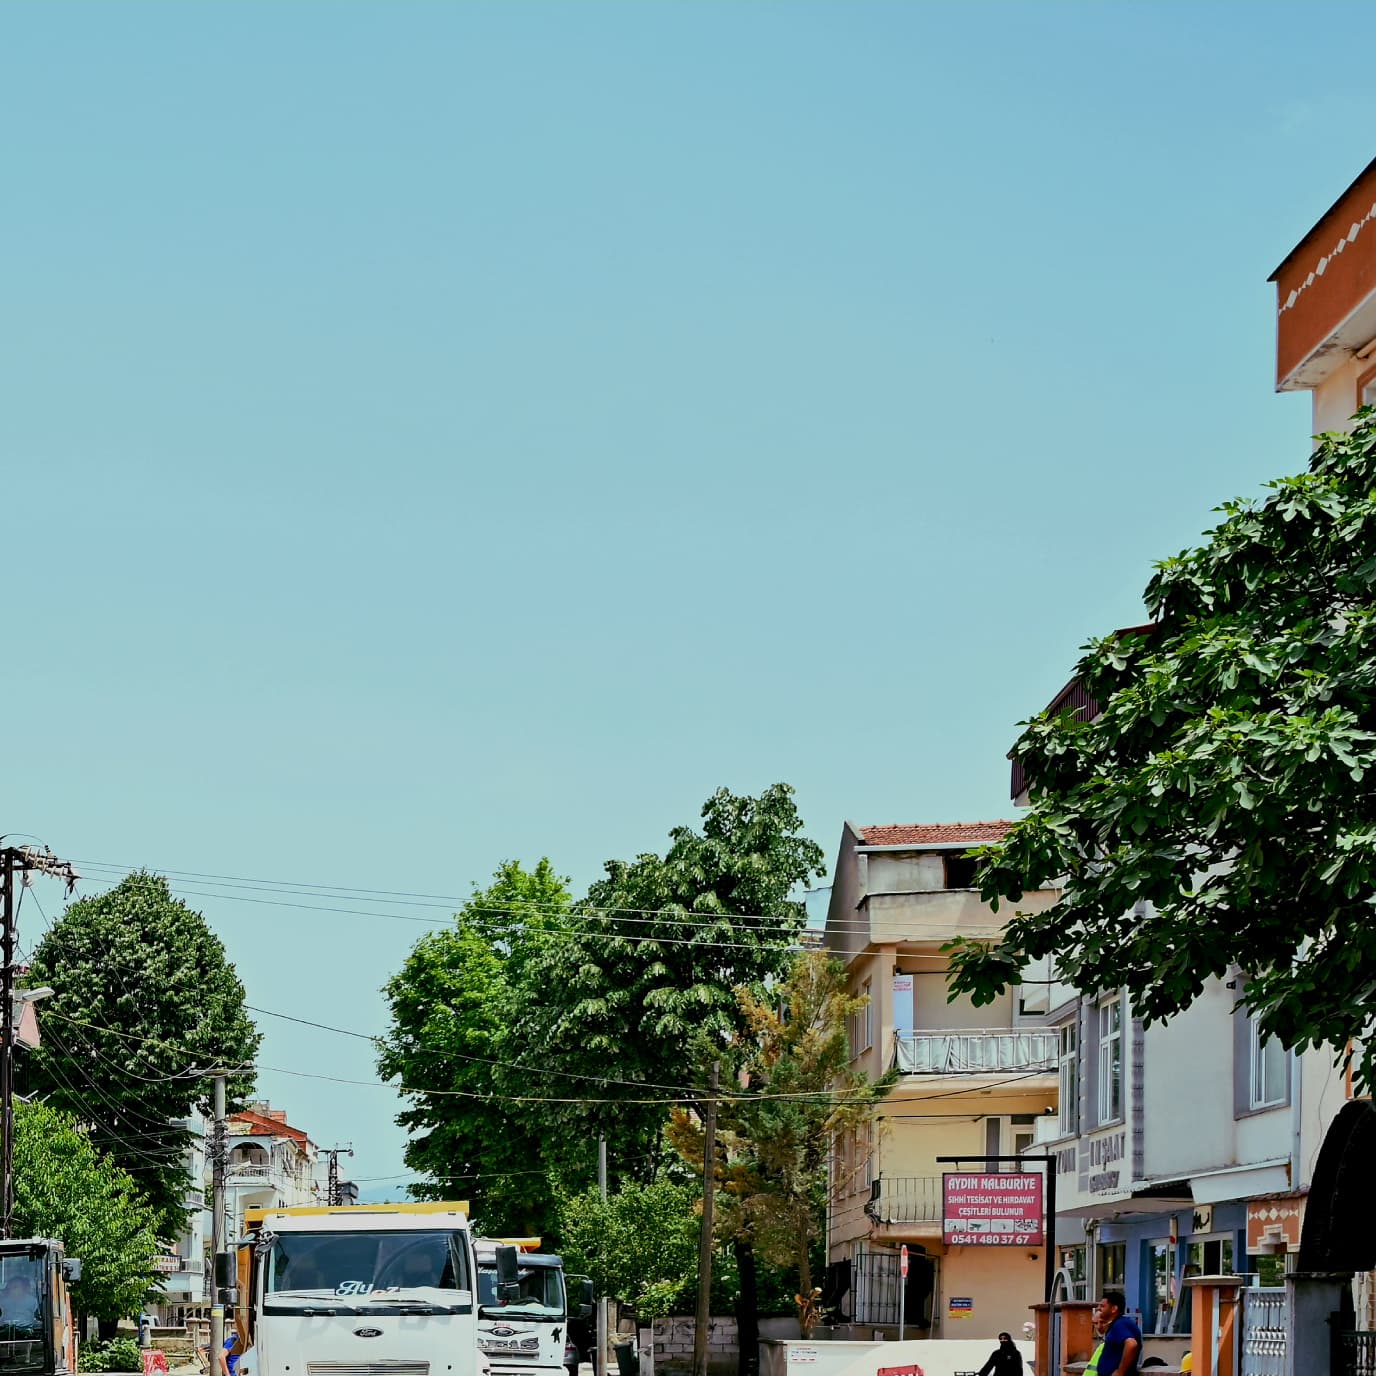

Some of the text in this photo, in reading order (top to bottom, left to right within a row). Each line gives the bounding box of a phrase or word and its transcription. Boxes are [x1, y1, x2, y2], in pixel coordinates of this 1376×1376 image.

[949, 1176, 1036, 1190] AYDIN NALBURİYE
[967, 1194, 993, 1204] TESİSAT
[993, 1196, 1002, 1204] VE
[952, 1235, 1029, 1244] 0541 480 37 67
[359, 1327, 377, 1337] Ford
